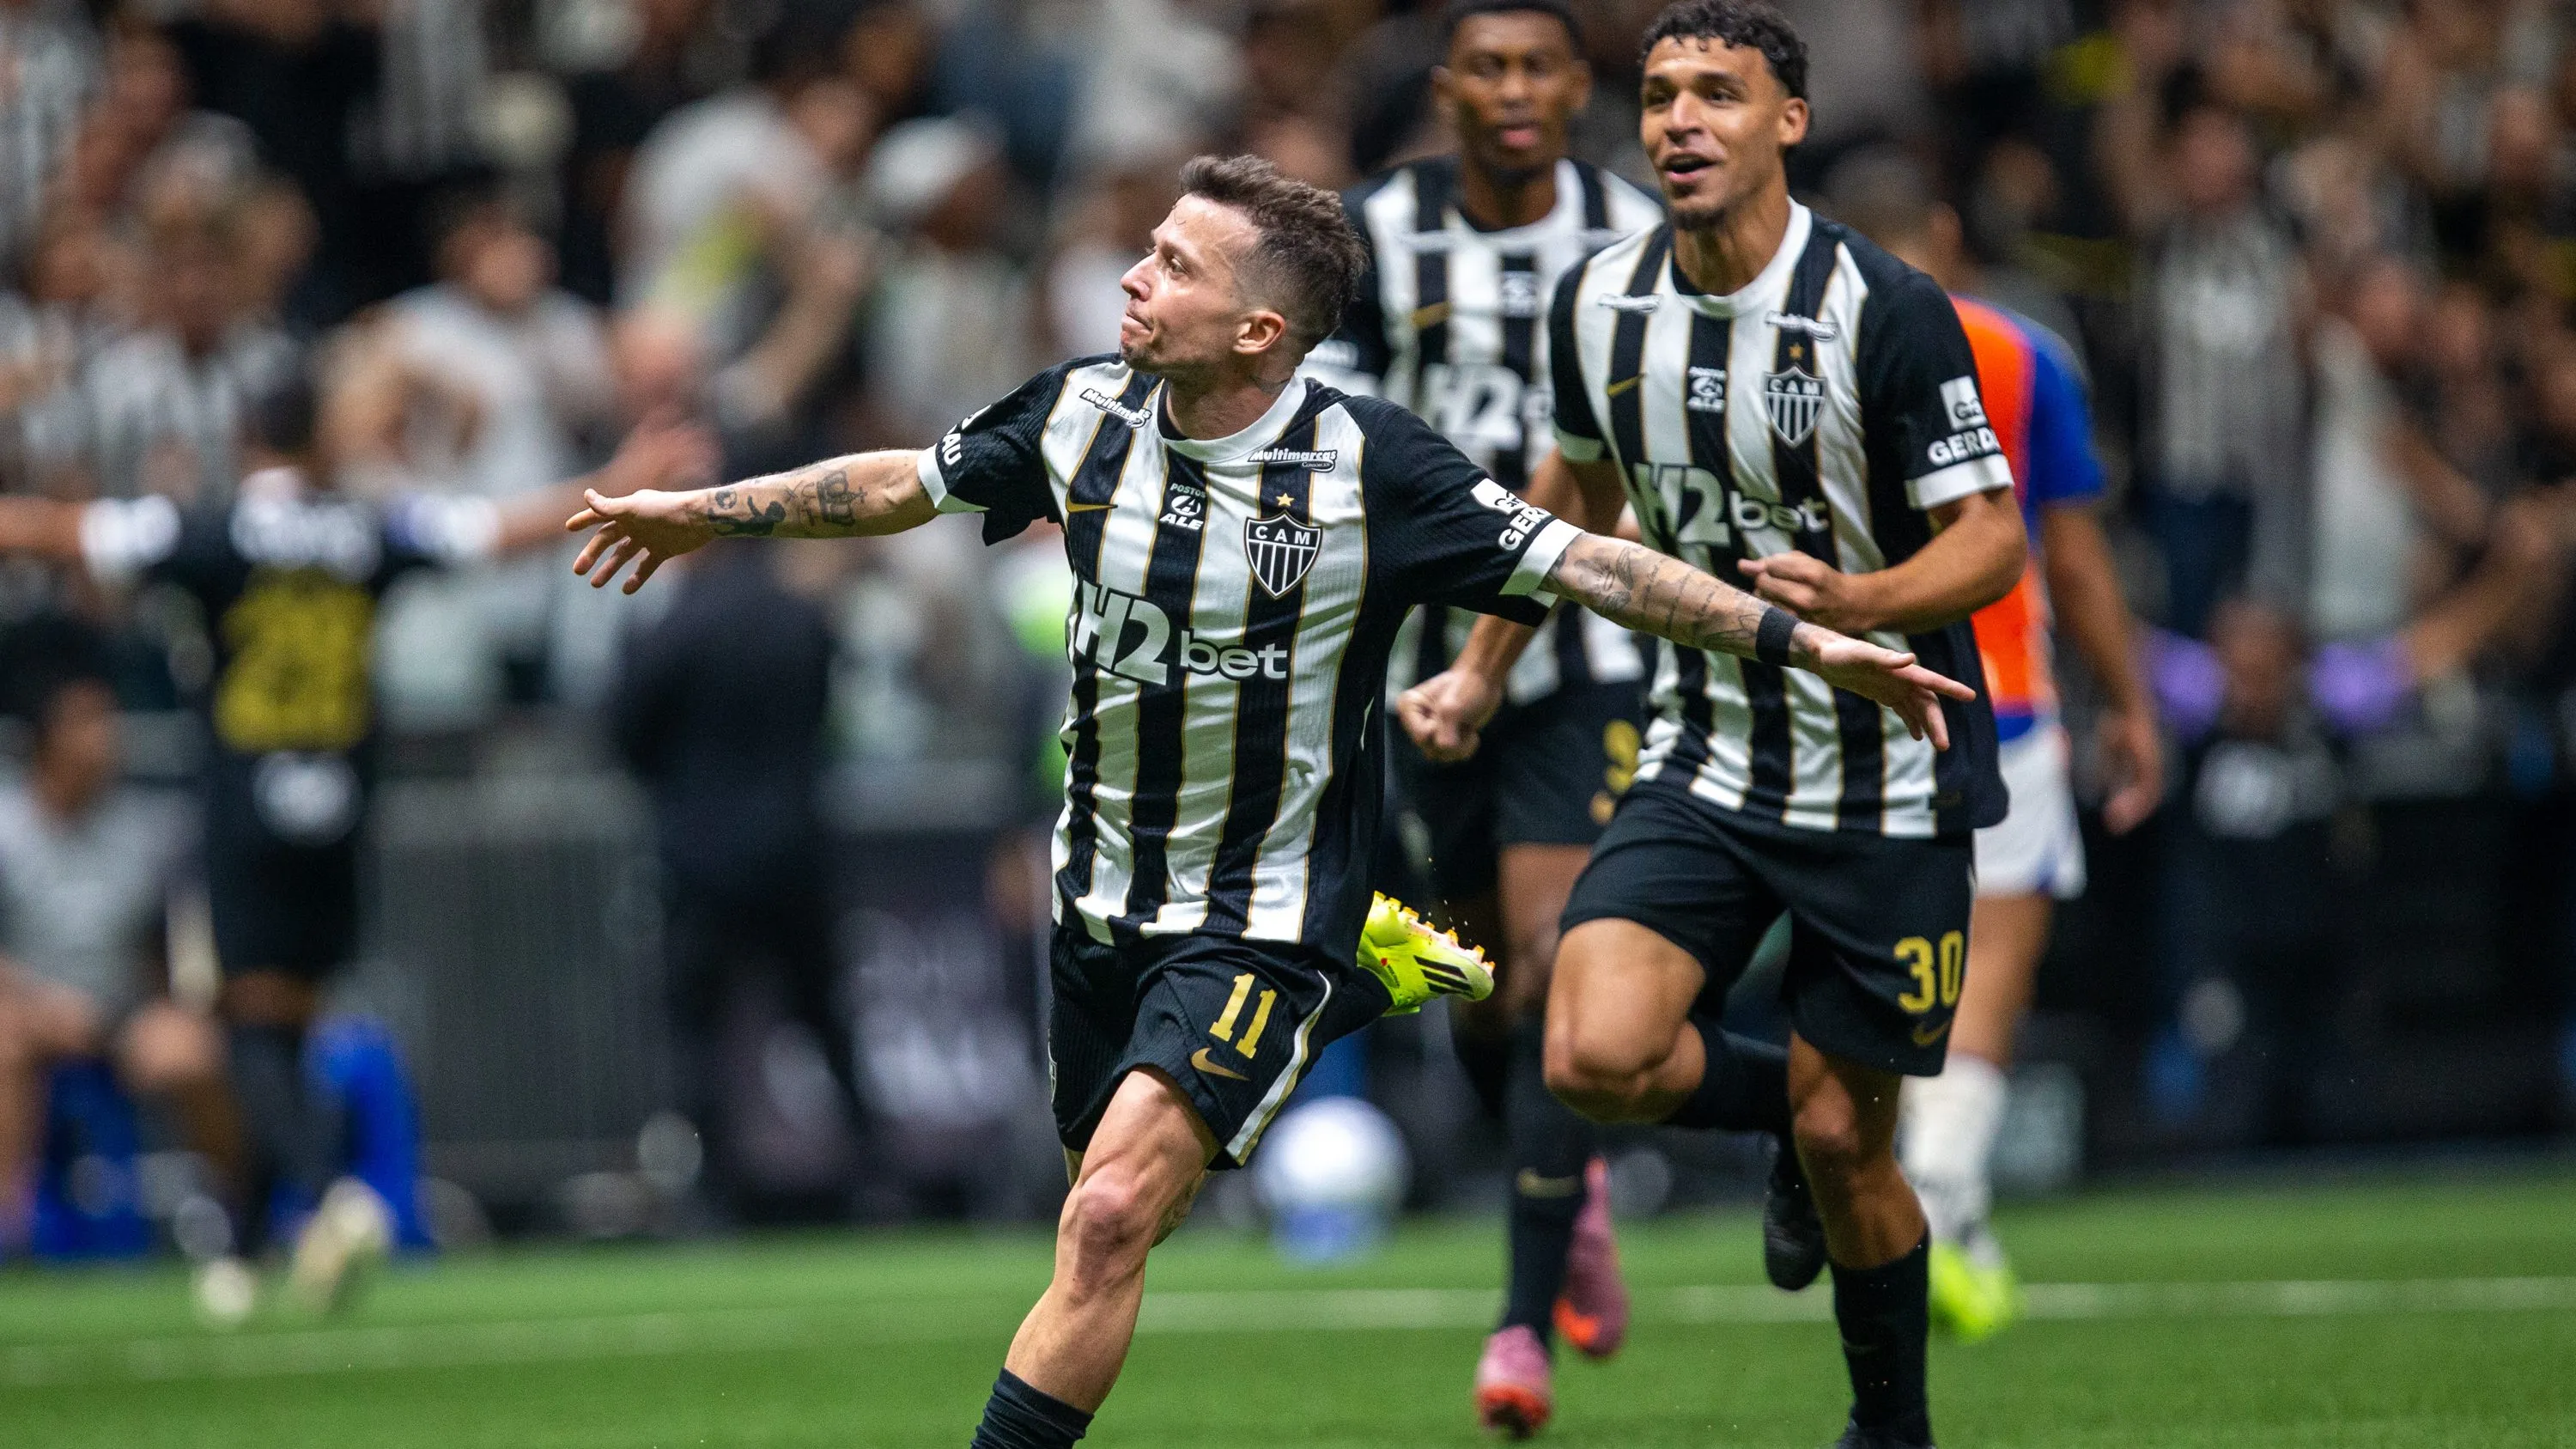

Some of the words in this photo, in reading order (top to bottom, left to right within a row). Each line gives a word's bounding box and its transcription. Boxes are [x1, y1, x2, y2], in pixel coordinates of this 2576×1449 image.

[1249, 447, 1338, 462] Multimarcas
[1170, 483, 1206, 498] POSTOS
[1159, 513, 1204, 530] ALE
[1255, 525, 1311, 545] CAM
[1893, 930, 1964, 1013] 30
[1209, 973, 1278, 1059] 11
